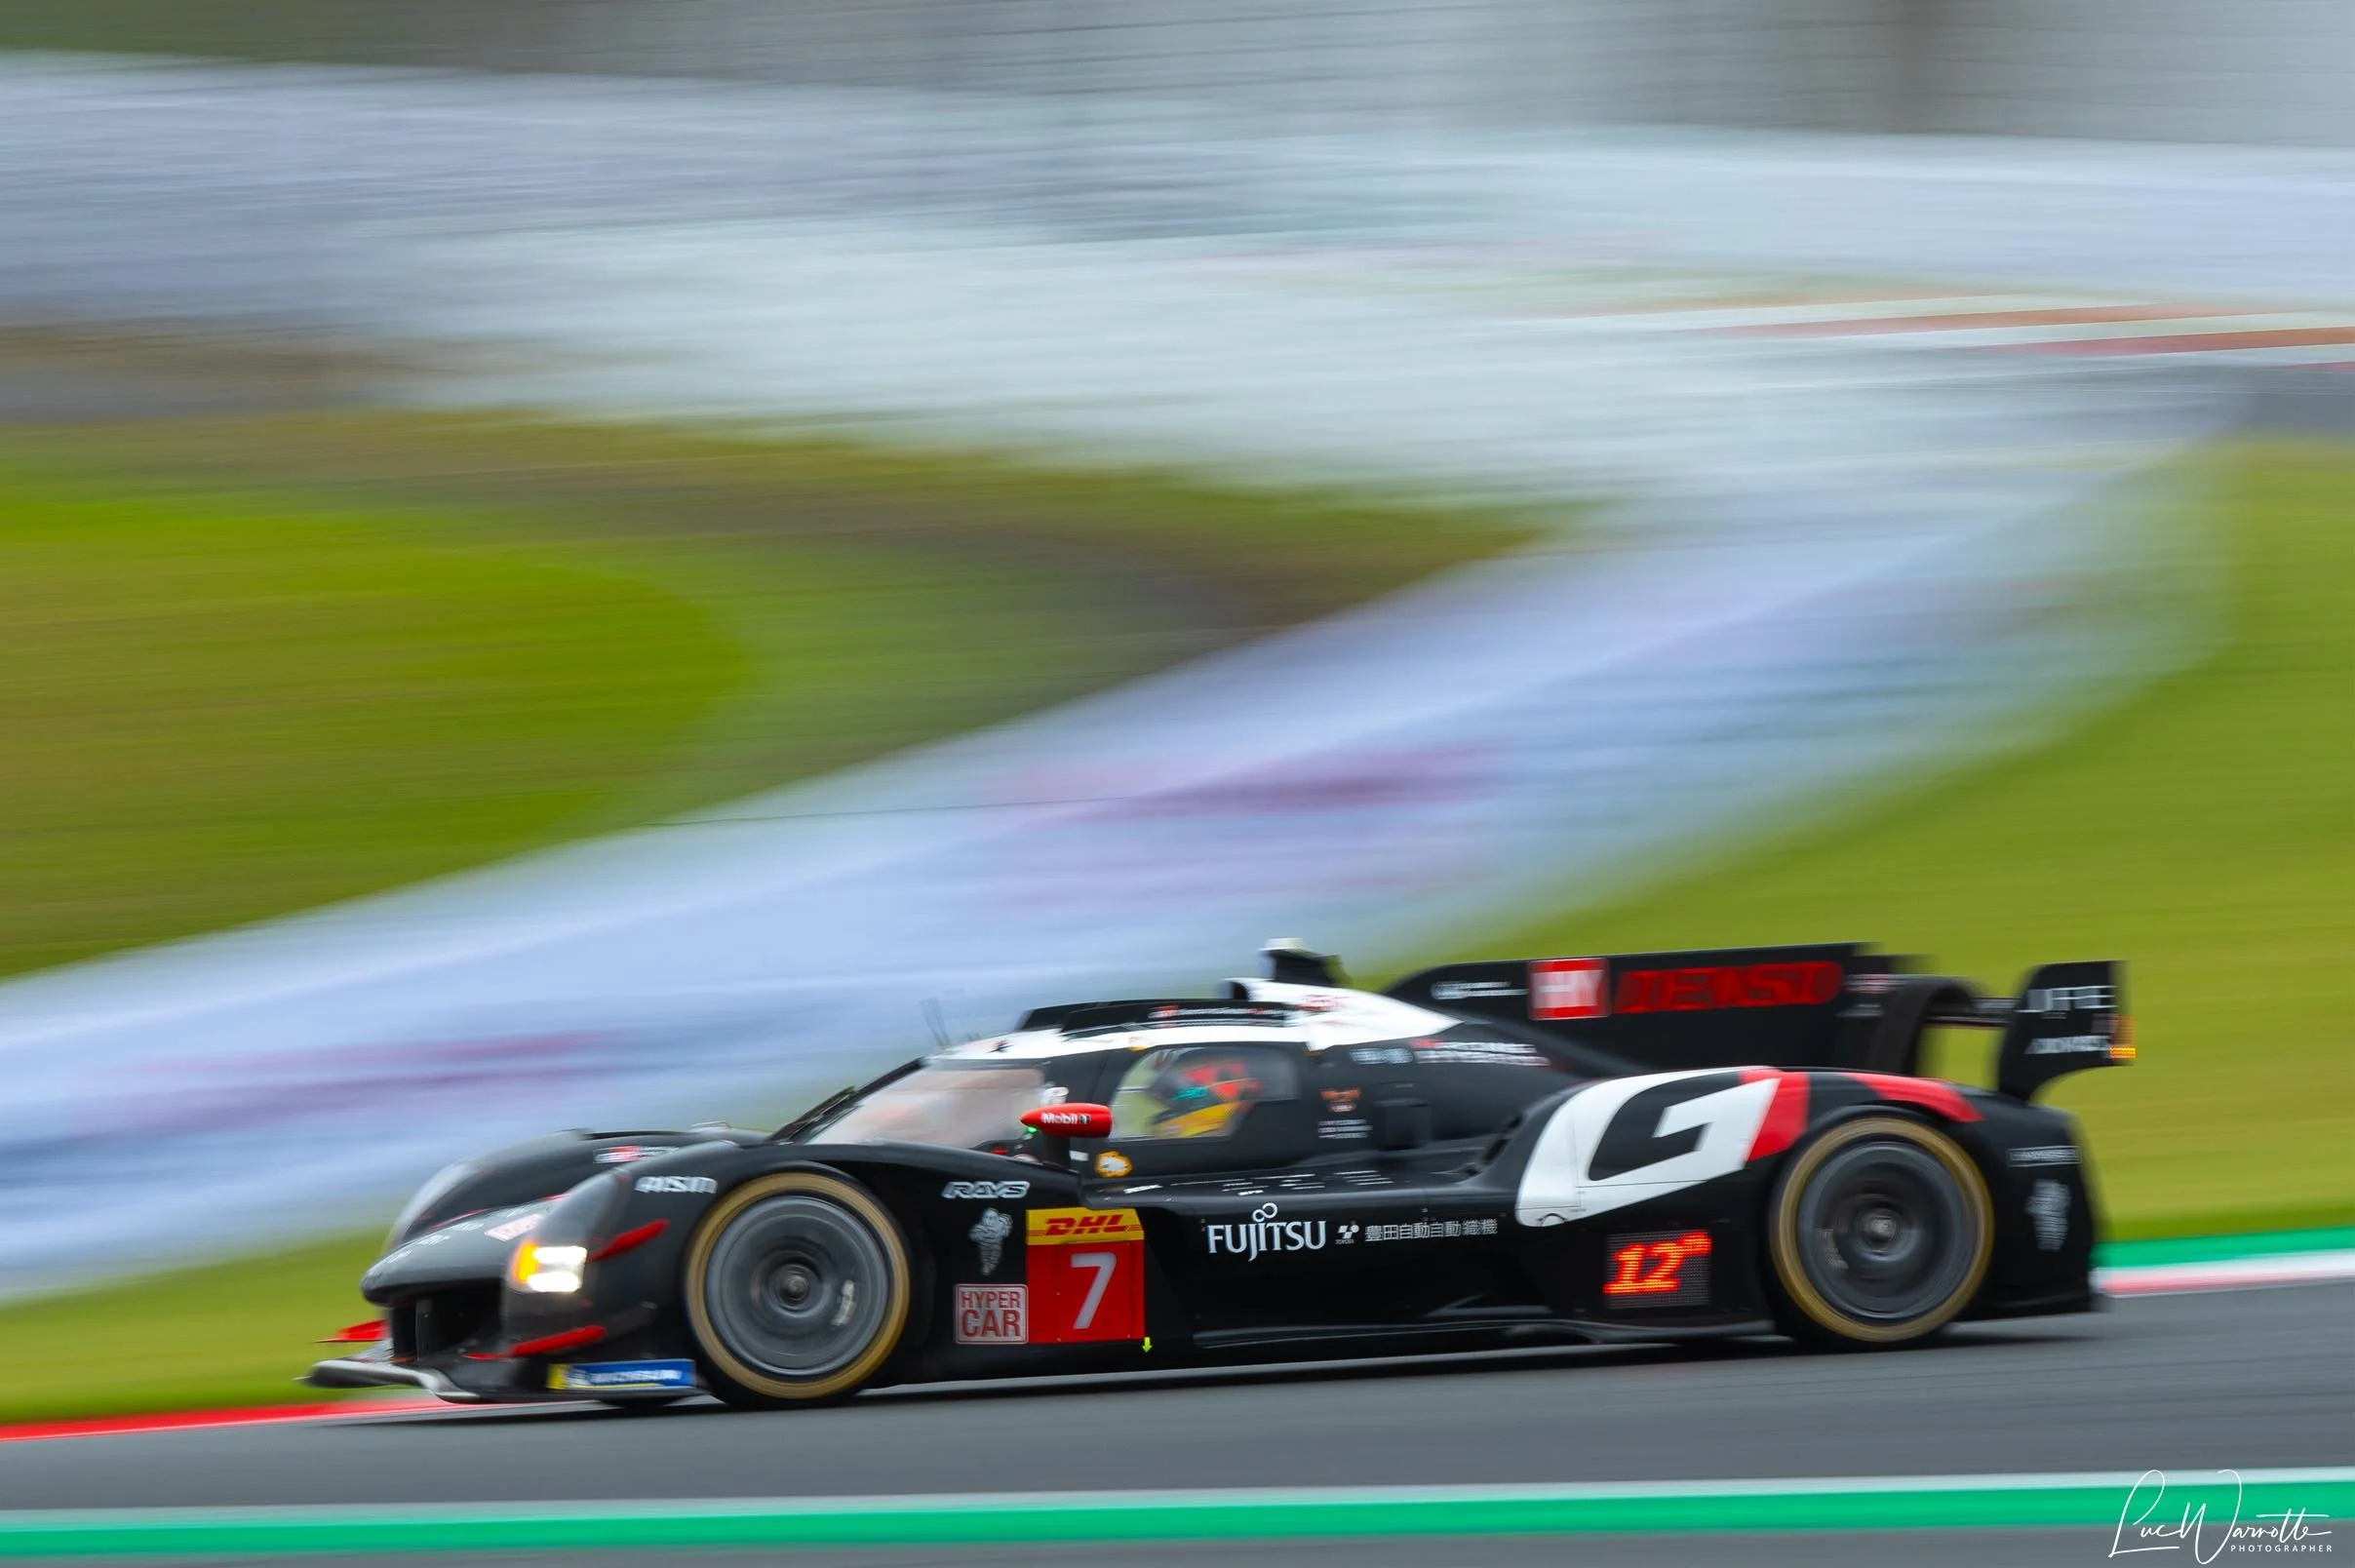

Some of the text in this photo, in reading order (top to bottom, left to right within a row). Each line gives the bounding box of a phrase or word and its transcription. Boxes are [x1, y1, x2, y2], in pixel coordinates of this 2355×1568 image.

[1041, 1113, 1078, 1124] Mobil
[941, 1180, 1031, 1199] RAYS
[1044, 1214, 1128, 1236] DHL
[1207, 1220, 1326, 1262] FUJITSU
[961, 1291, 1021, 1309] HYPER
[1070, 1251, 1118, 1330] 7
[961, 1310, 1021, 1338] CAR
